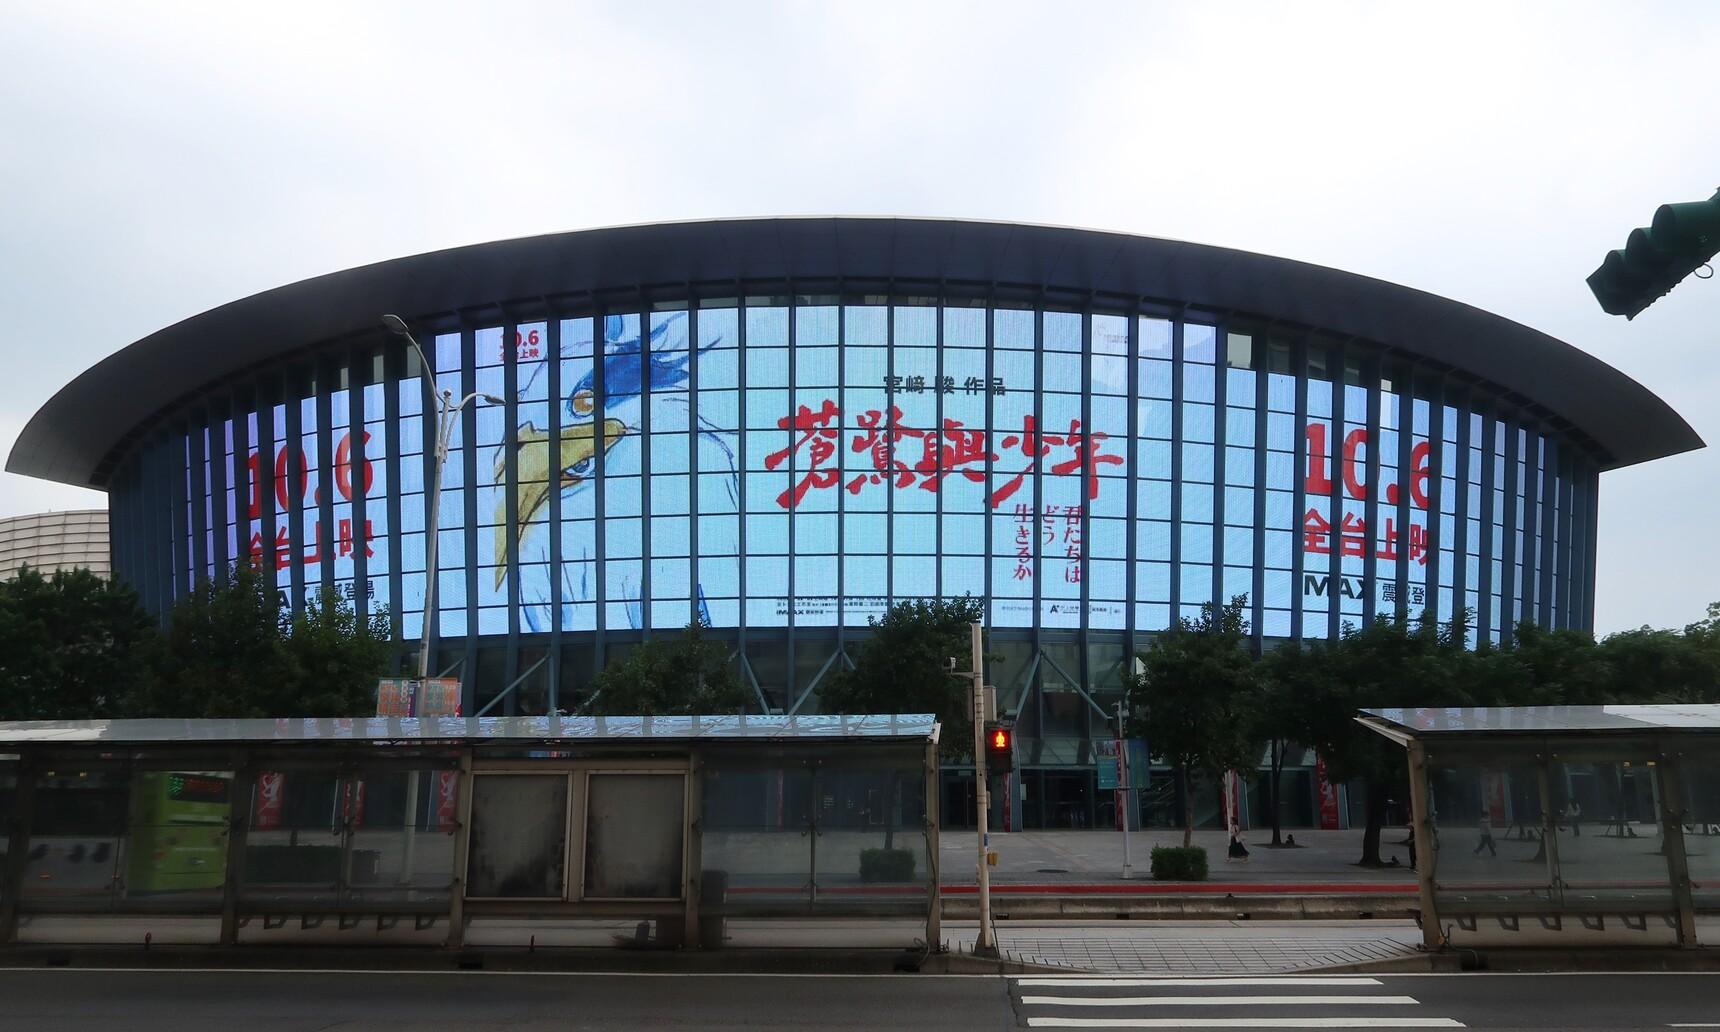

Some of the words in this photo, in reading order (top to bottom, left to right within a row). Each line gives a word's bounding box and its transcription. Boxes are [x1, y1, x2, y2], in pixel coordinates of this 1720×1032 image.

[1013, 504, 1034, 581] 生きるか
[1042, 504, 1060, 545] どう
[1063, 505, 1082, 583] 君たちは
